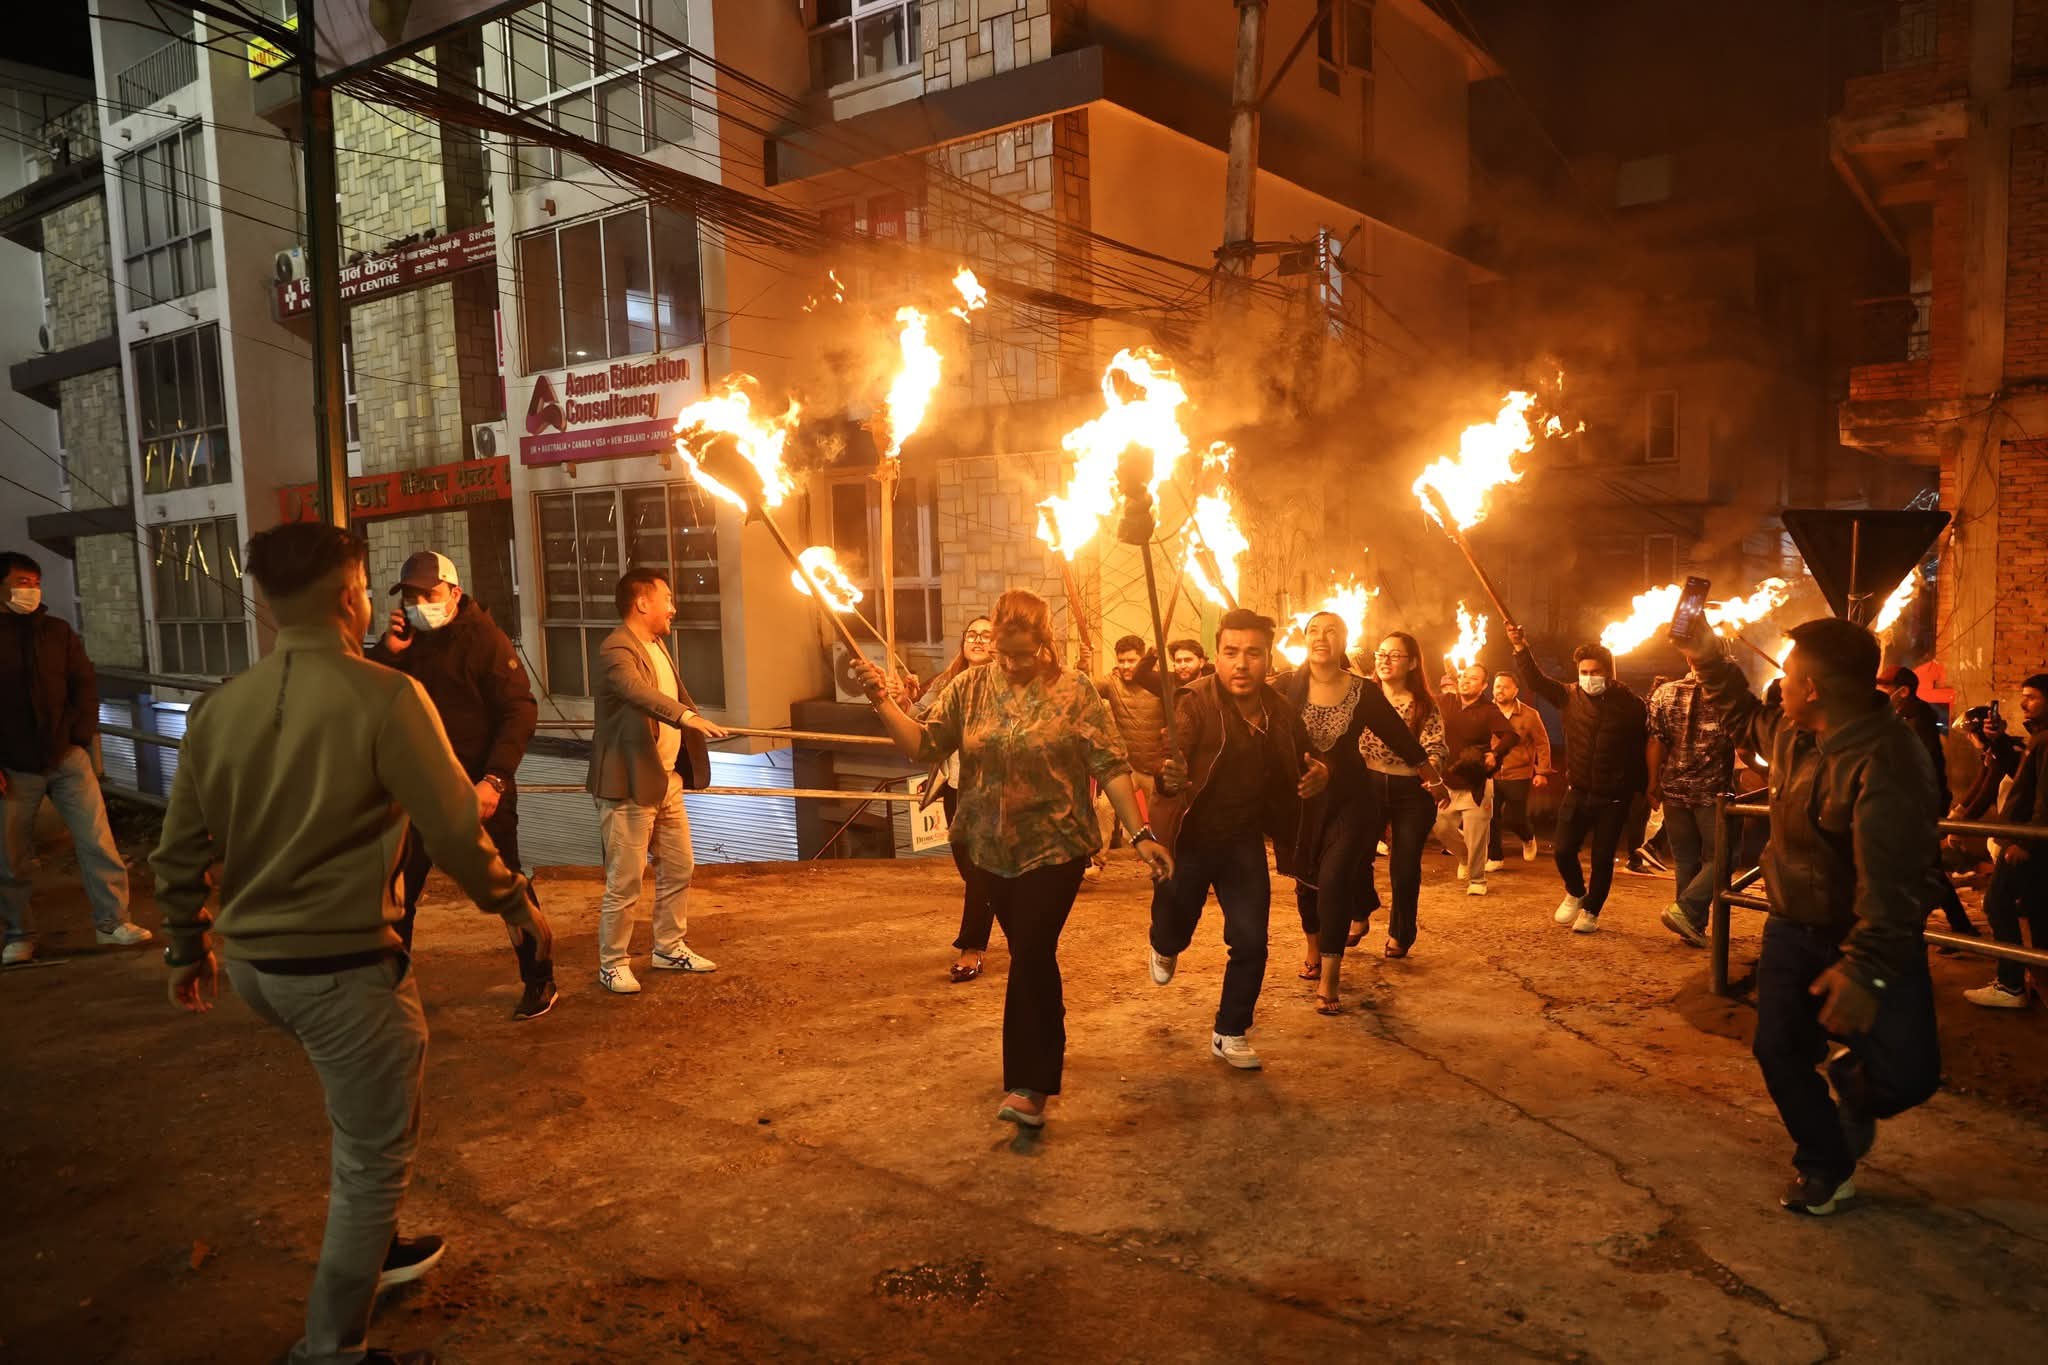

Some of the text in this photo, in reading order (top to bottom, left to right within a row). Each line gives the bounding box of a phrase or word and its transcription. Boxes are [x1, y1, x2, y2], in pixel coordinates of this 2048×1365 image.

[360, 273, 400, 292] CENTRE
[566, 357, 690, 395] Aama Education
[565, 392, 660, 424] Consultancy
[541, 442, 567, 453] AUSTRALIA
[572, 439, 592, 449] CANADA
[595, 438, 606, 447] USA
[610, 436, 622, 445] NEW
[623, 433, 646, 444] ZEALAND
[651, 431, 667, 441] JAPAN
